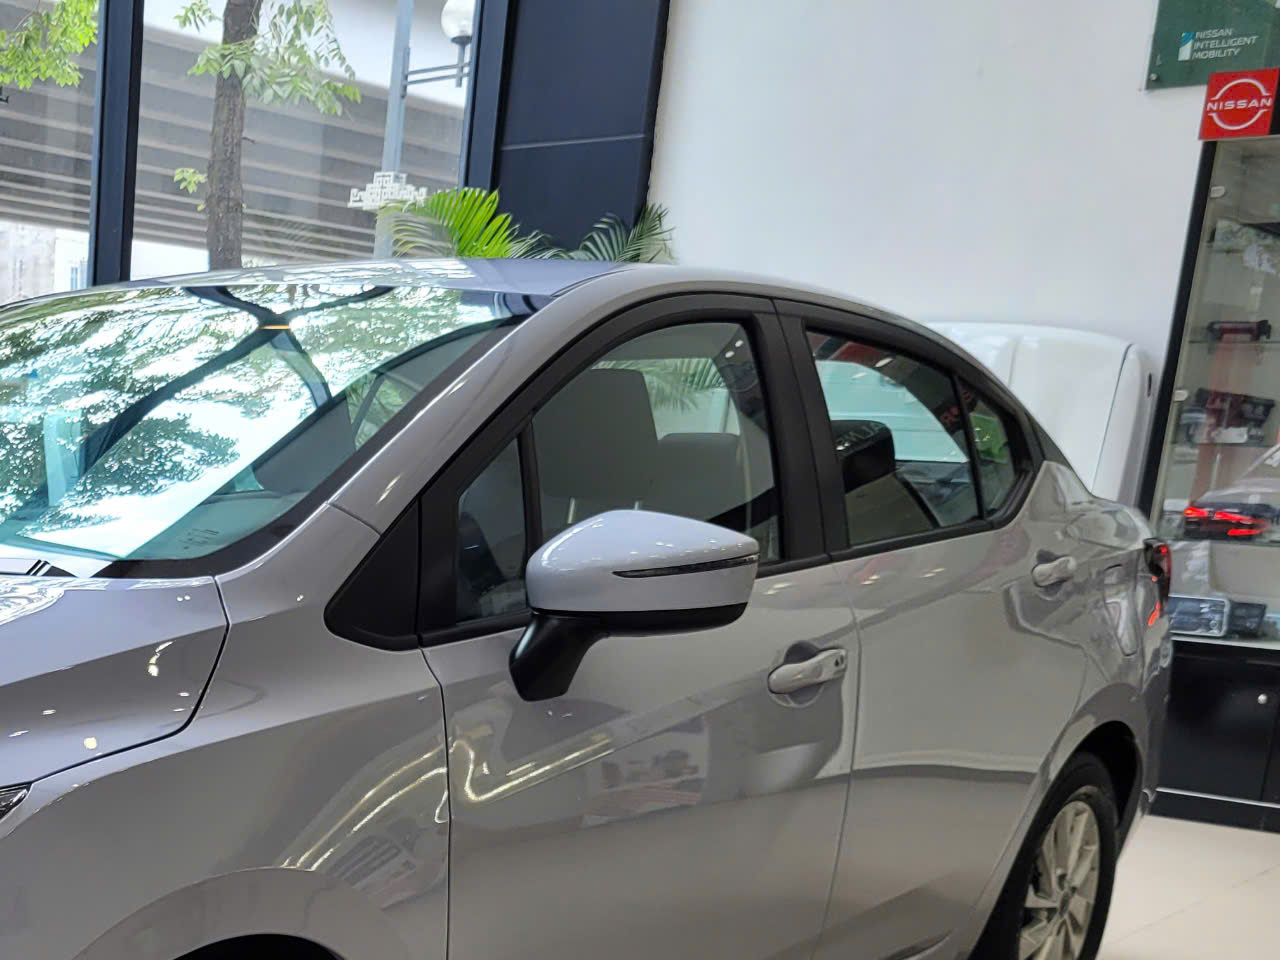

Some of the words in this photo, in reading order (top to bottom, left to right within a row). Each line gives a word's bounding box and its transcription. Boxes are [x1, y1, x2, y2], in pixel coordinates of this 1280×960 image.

[1196, 28, 1232, 39] NISSAN
[1194, 35, 1258, 49] INTELLIGENT
[1192, 48, 1240, 59] MOBILITY
[1207, 98, 1272, 110] NISSAN
